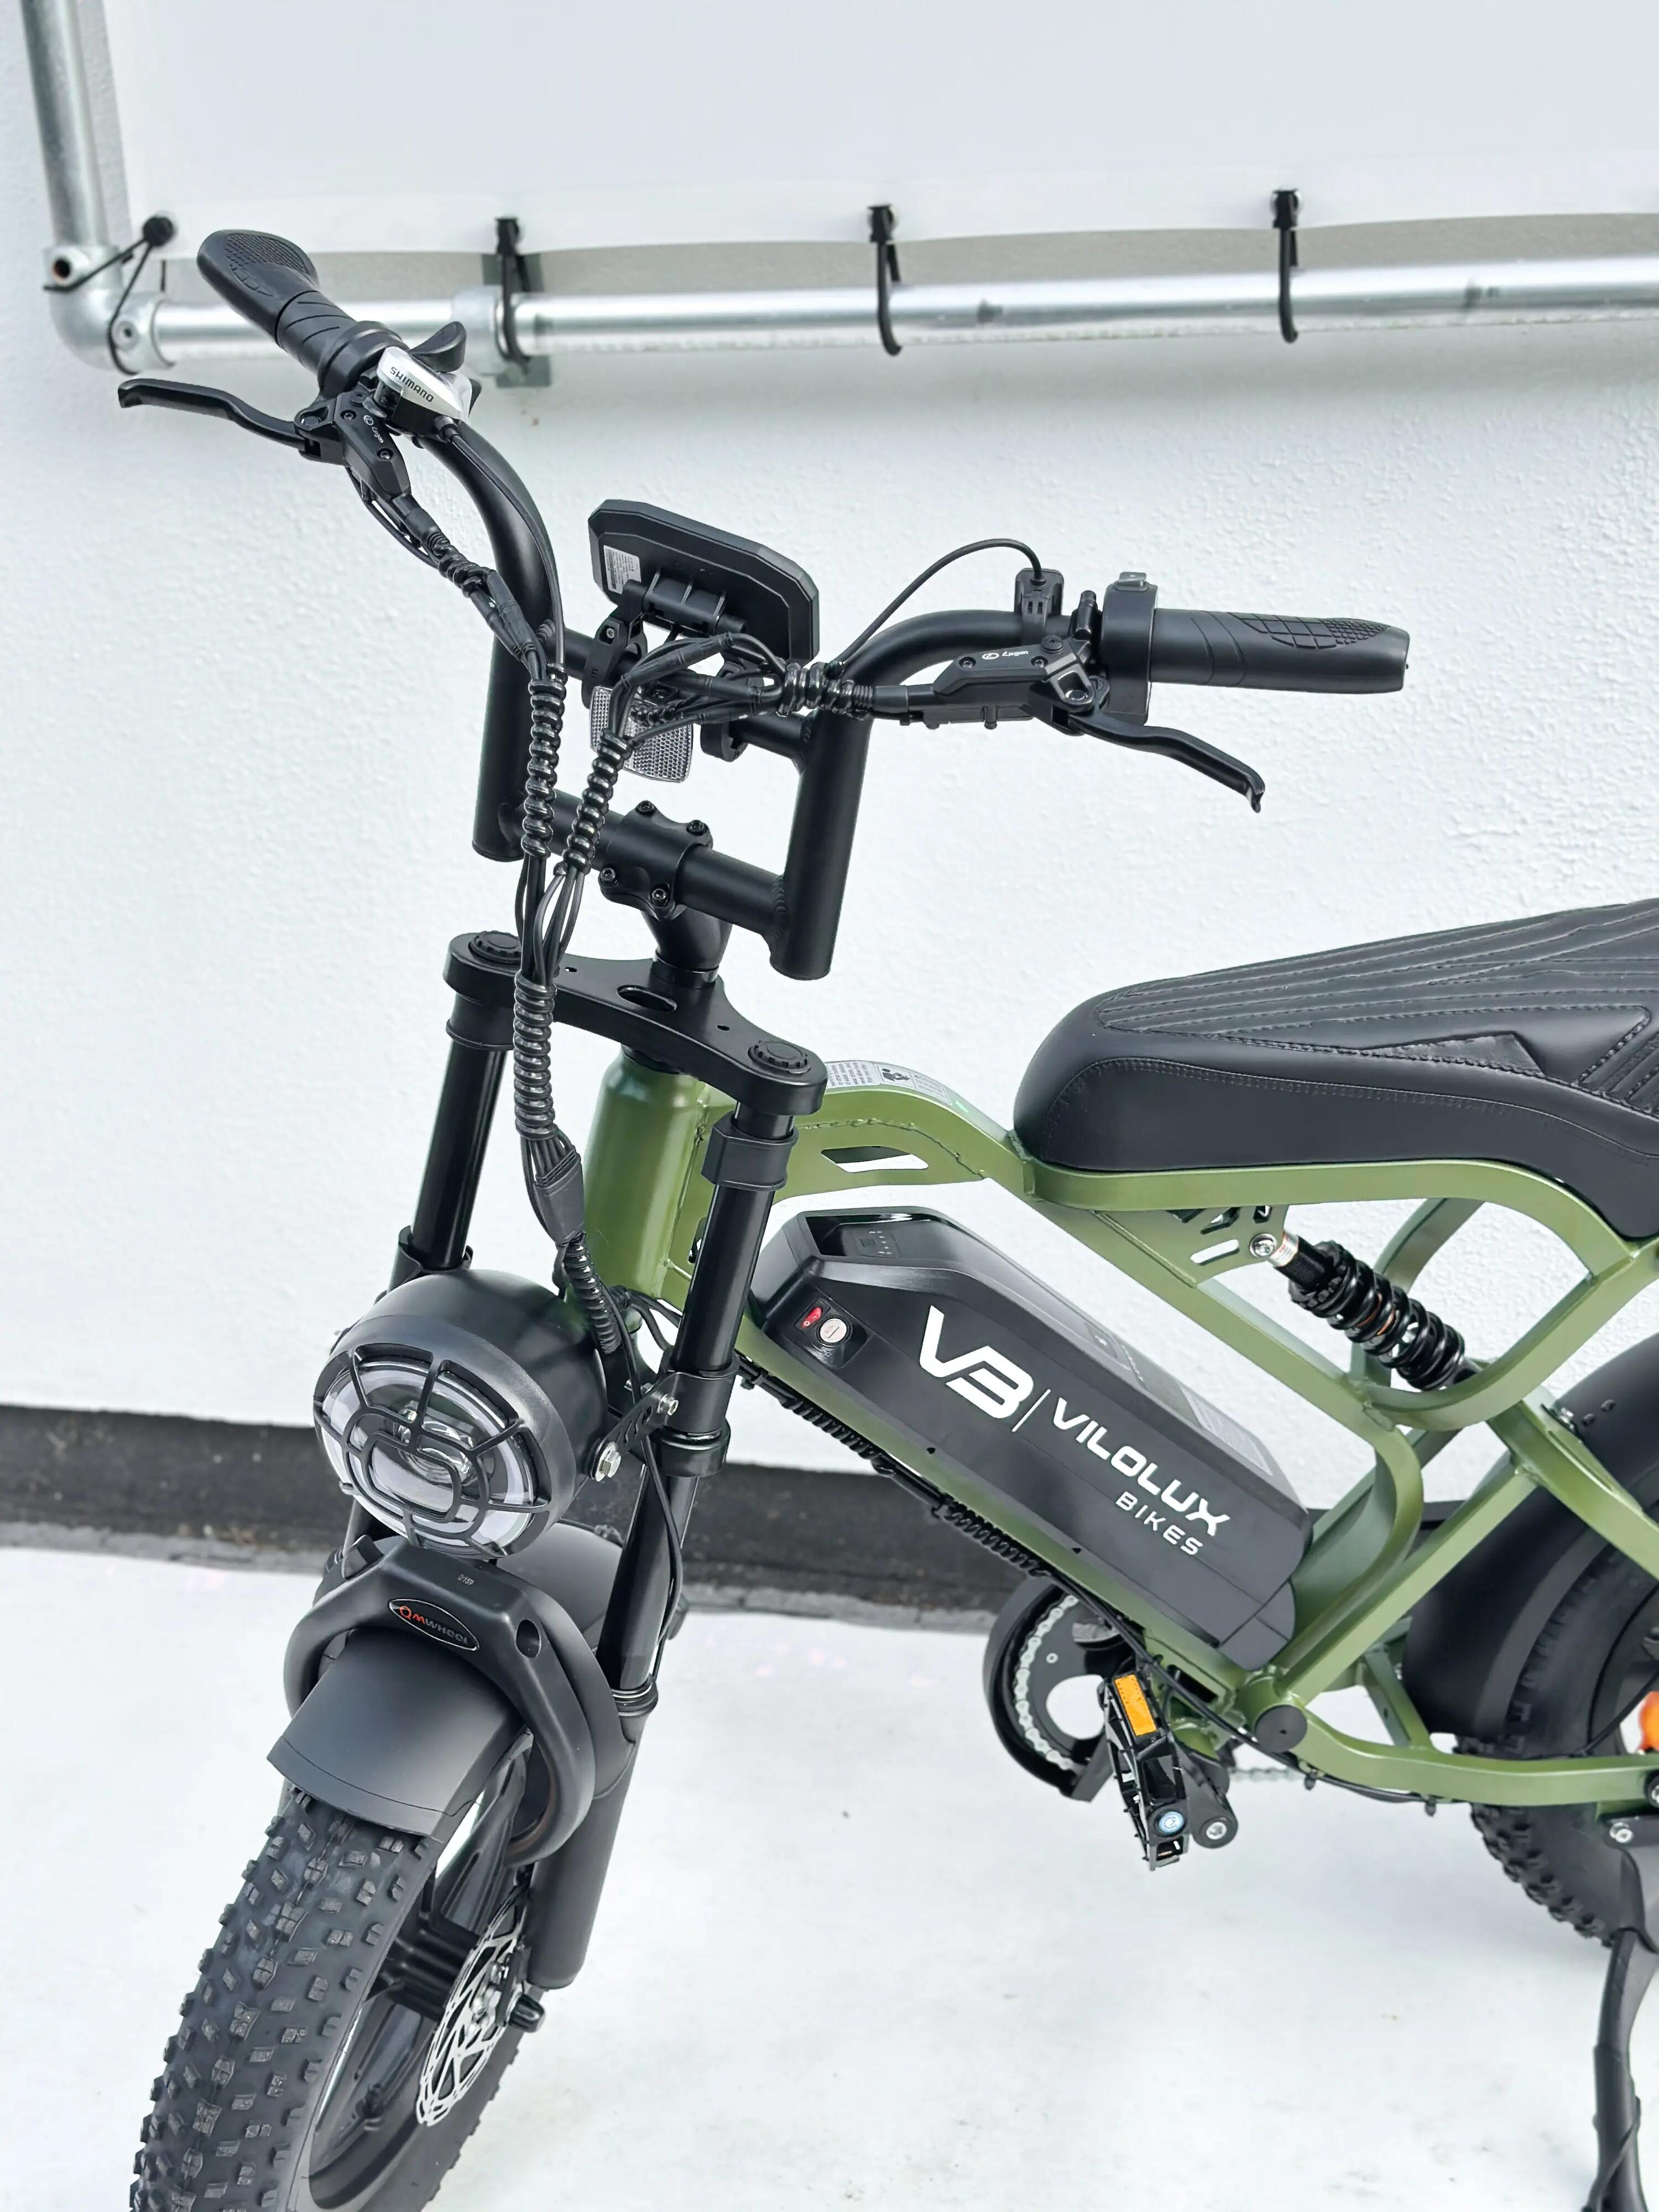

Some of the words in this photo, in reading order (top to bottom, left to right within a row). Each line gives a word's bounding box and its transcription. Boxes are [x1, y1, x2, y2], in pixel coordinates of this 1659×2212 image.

[389, 366, 434, 403] SHIMANO
[1052, 1397, 1231, 1537] VILOLUX
[1115, 1490, 1204, 1556] BIKES
